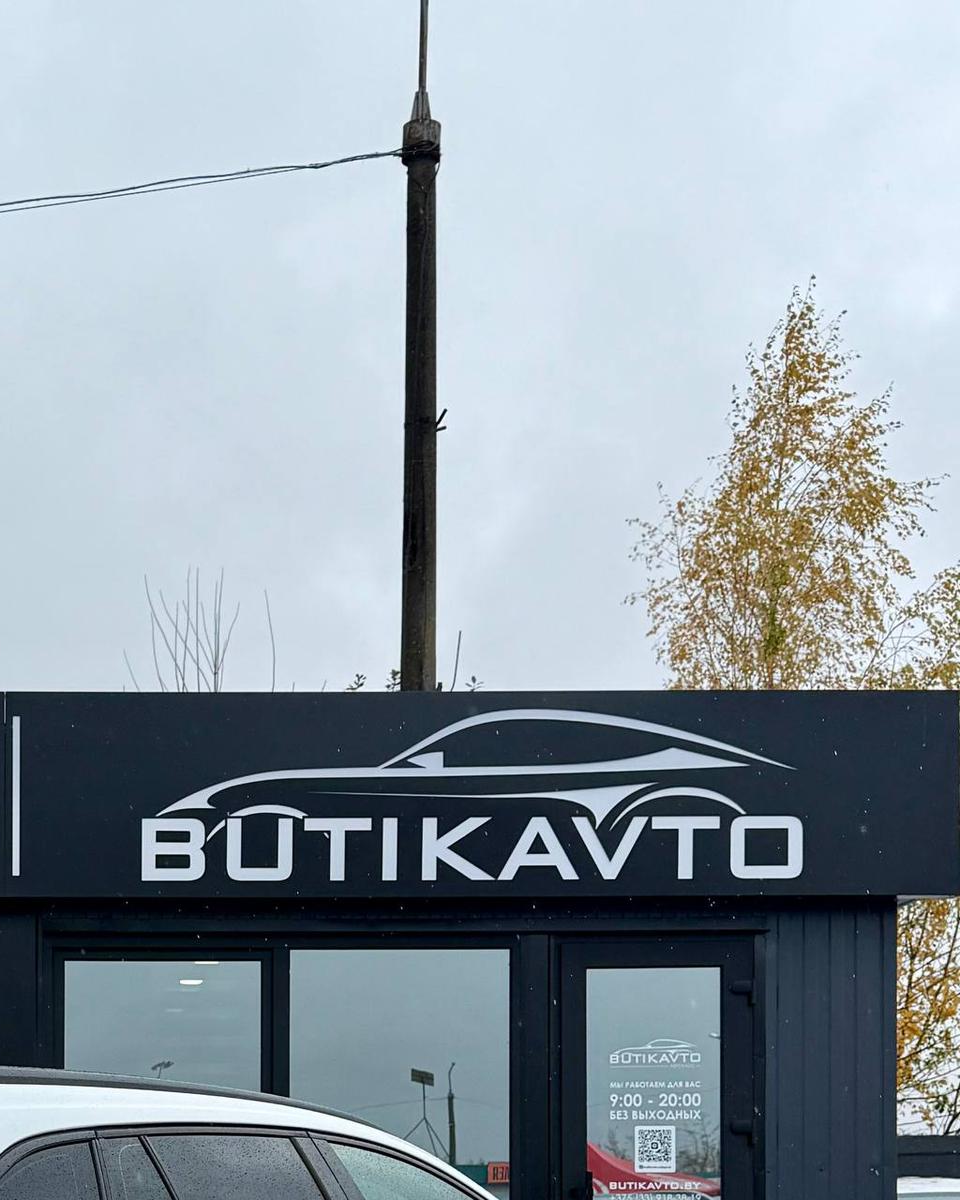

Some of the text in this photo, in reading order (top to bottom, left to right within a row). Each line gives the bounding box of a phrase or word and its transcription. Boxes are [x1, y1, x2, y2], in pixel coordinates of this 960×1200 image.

[141, 815, 805, 883] BUTIKAVTO
[609, 1052, 701, 1064] BUTIKAVTO
[610, 1093, 642, 1107] 9:00
[659, 1093, 701, 1107] 20:00
[610, 1110, 701, 1120] БЕЗ ВЫХОДНЫХ
[609, 1182, 701, 1190] BUTIKAVTO.BY
